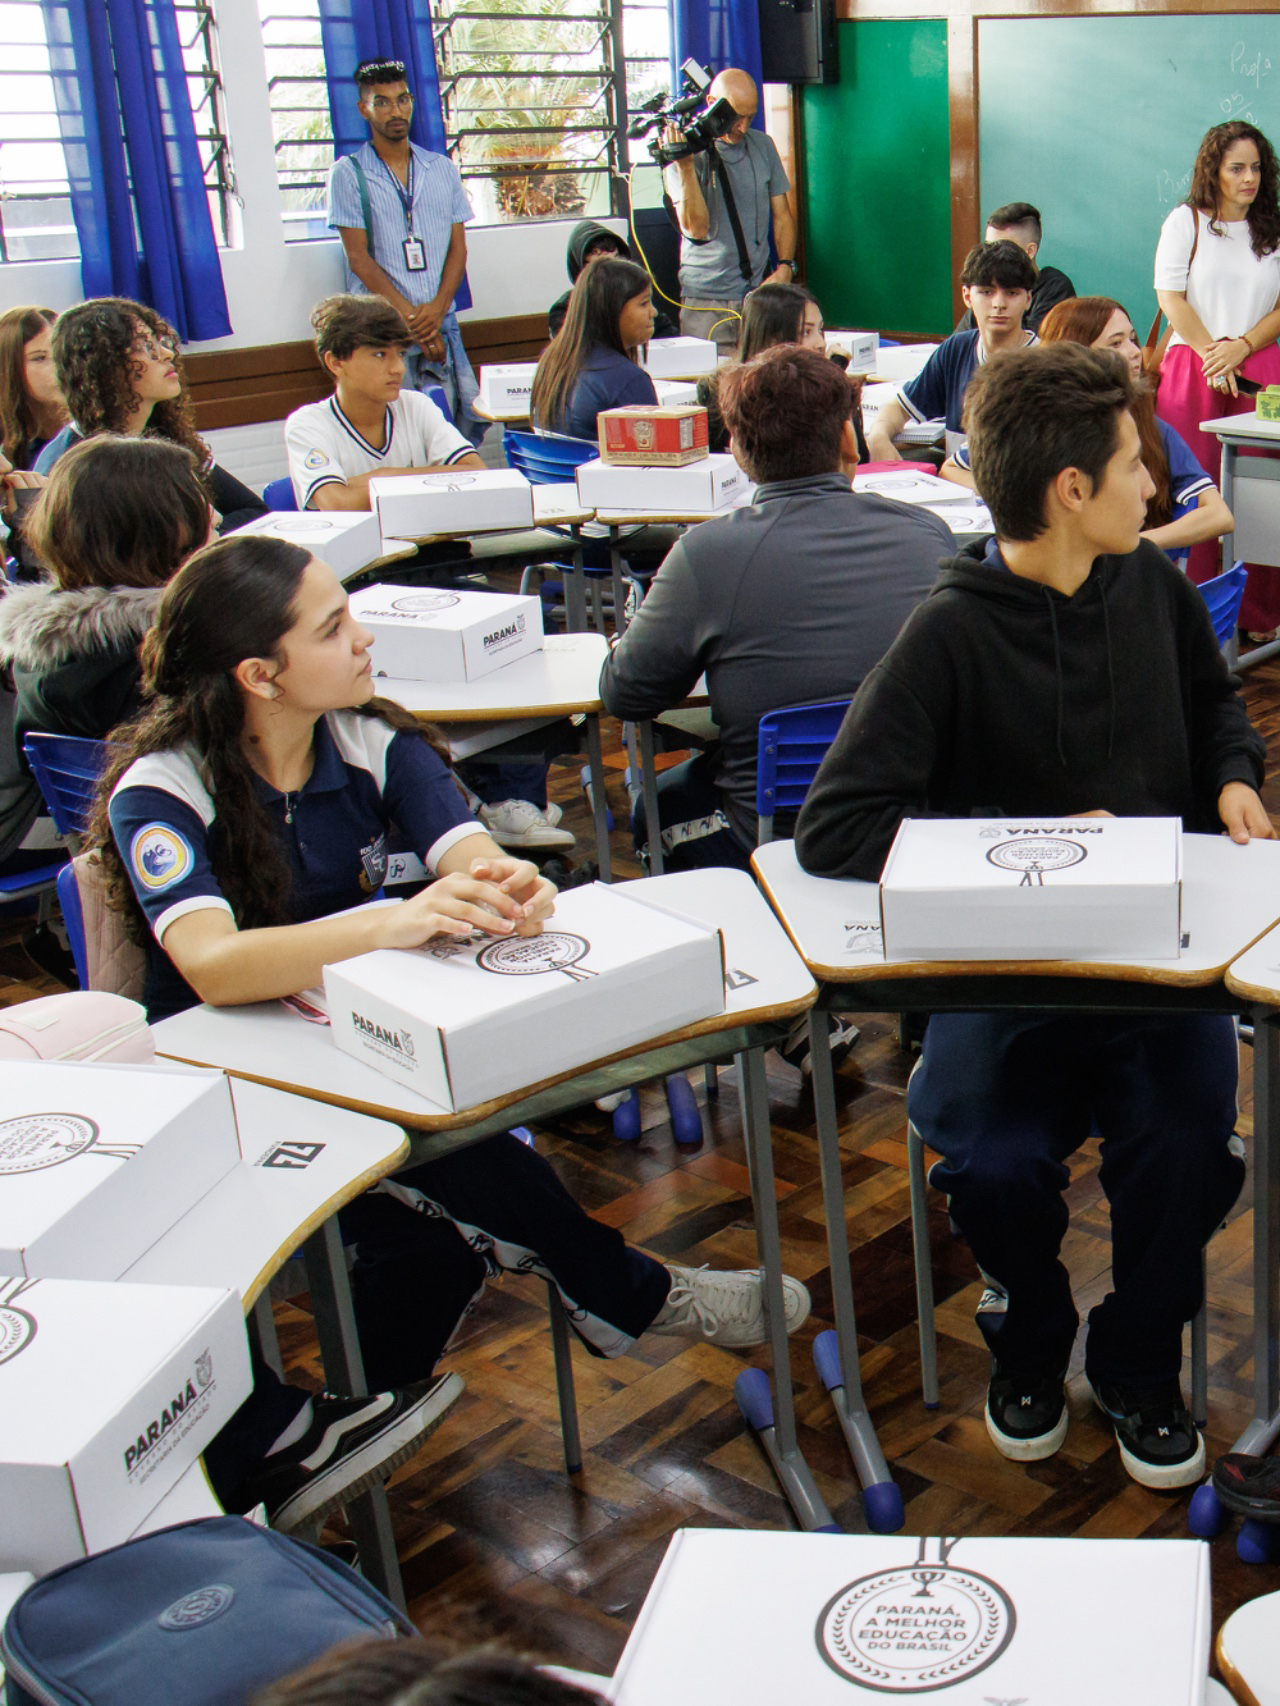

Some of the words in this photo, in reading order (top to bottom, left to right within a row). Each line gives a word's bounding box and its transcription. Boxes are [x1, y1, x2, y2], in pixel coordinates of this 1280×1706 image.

[483, 621, 518, 648] PARANÁ
[351, 1010, 403, 1052] PARANÁ
[124, 1377, 198, 1472] PARANÁ
[875, 1603, 961, 1617] PARANÁ,
[866, 1617, 878, 1627] A
[885, 1618, 966, 1628] MELHOR
[858, 1628, 967, 1641] EDUCAÇÃO
[867, 1641, 891, 1650] DO
[895, 1641, 953, 1652] BRASIL
